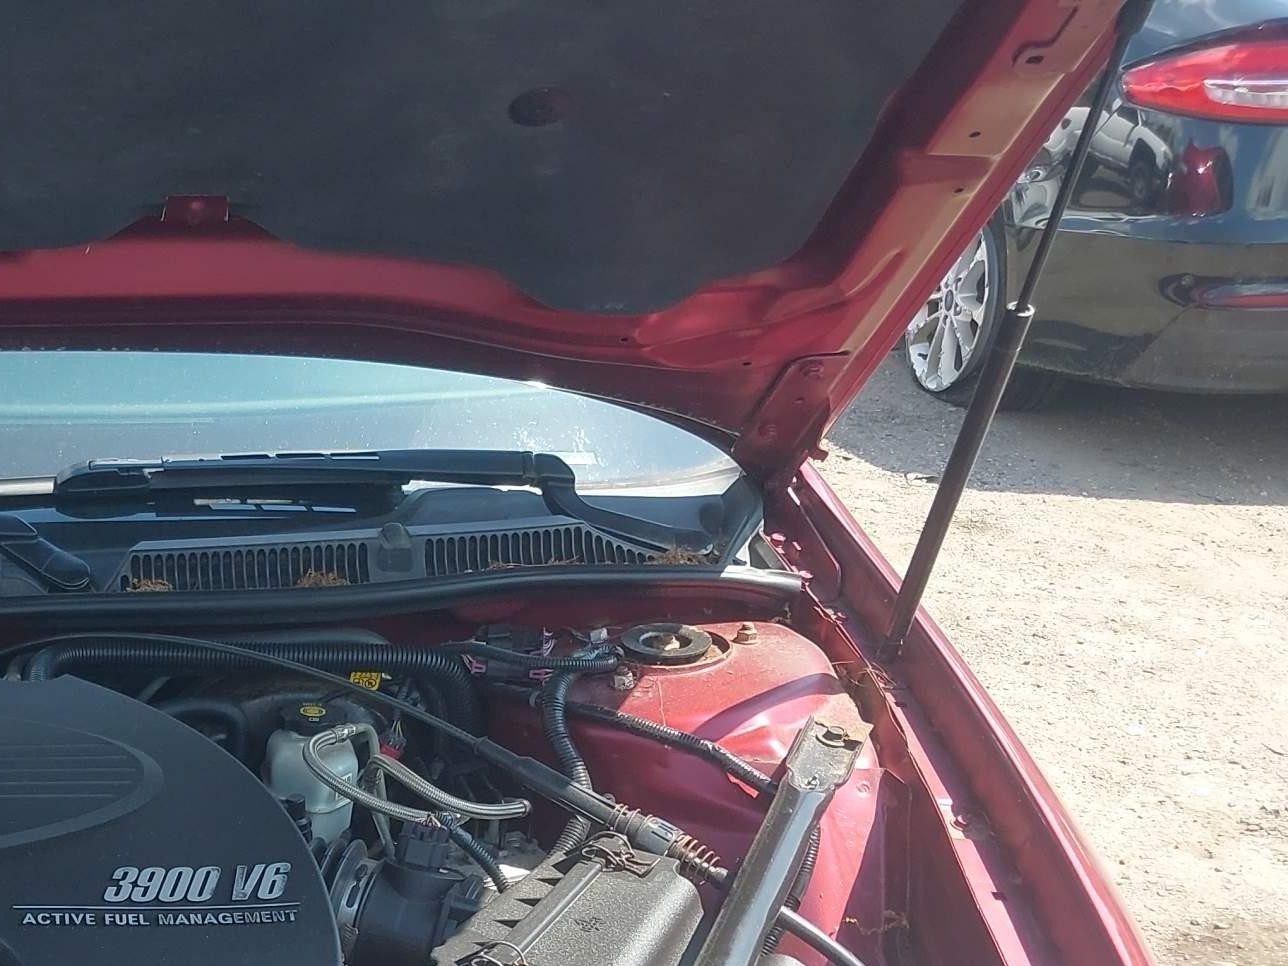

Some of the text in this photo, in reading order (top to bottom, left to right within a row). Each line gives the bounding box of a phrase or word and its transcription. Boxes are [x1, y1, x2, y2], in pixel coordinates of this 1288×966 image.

[103, 862, 292, 903] 3900 V6
[22, 909, 299, 926] ACTIVE FUEL MANAGEMENT
